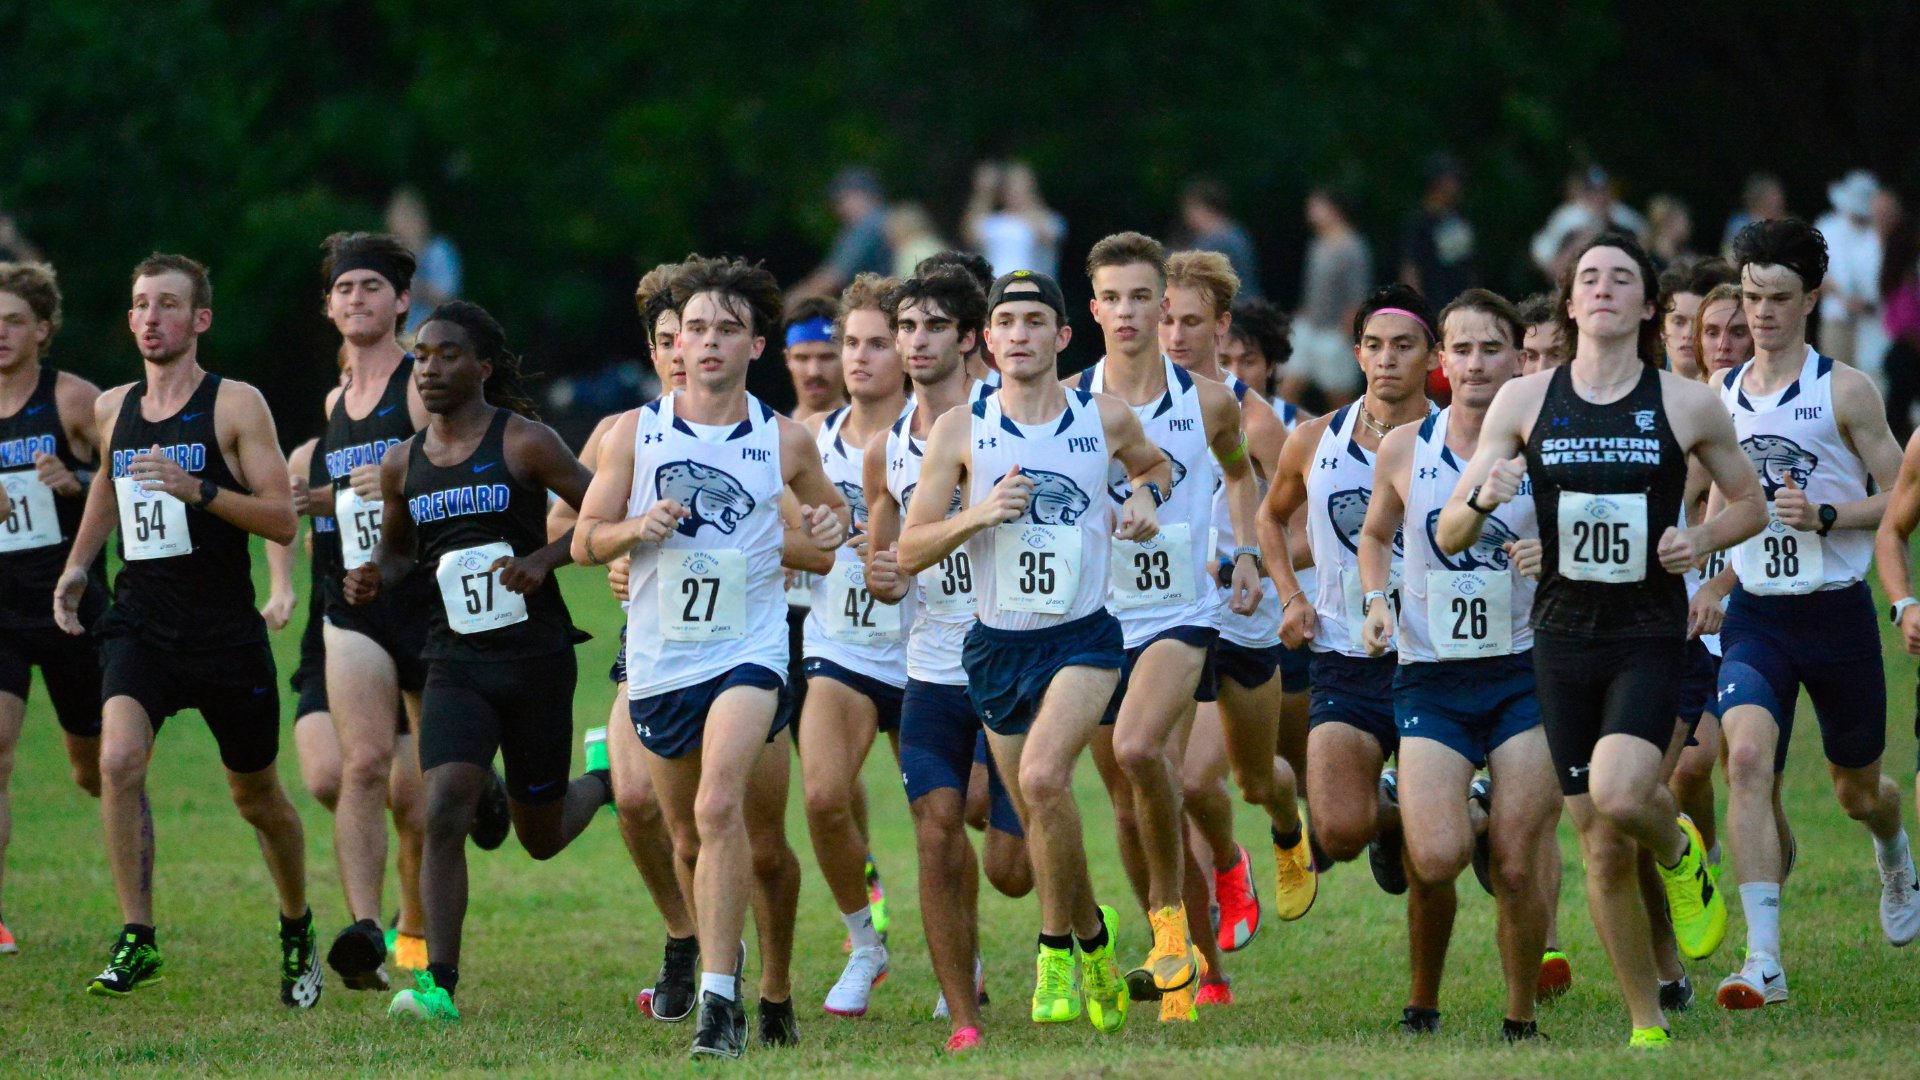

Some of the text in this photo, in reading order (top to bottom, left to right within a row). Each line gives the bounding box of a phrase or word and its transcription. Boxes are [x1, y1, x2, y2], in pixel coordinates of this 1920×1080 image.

[1169, 418, 1194, 431] PBC
[1795, 406, 1822, 420] PBC
[742, 447, 771, 463] PBC
[1068, 436, 1101, 453] PBC
[1541, 450, 1660, 466] WESLEYAN
[1542, 437, 1660, 451] SOUTHERN
[134, 500, 166, 542] 54
[409, 484, 510, 526] BREVARD
[354, 509, 382, 551] 55
[1032, 526, 1056, 541] OPENER
[1573, 520, 1630, 565] 205
[939, 552, 973, 596] 39
[1019, 551, 1056, 595] 35
[1134, 551, 1171, 592] 33
[1764, 535, 1799, 578] 38
[461, 571, 494, 615] 57
[682, 577, 720, 622] 27
[844, 588, 876, 627] 42
[1451, 597, 1488, 640] 26
